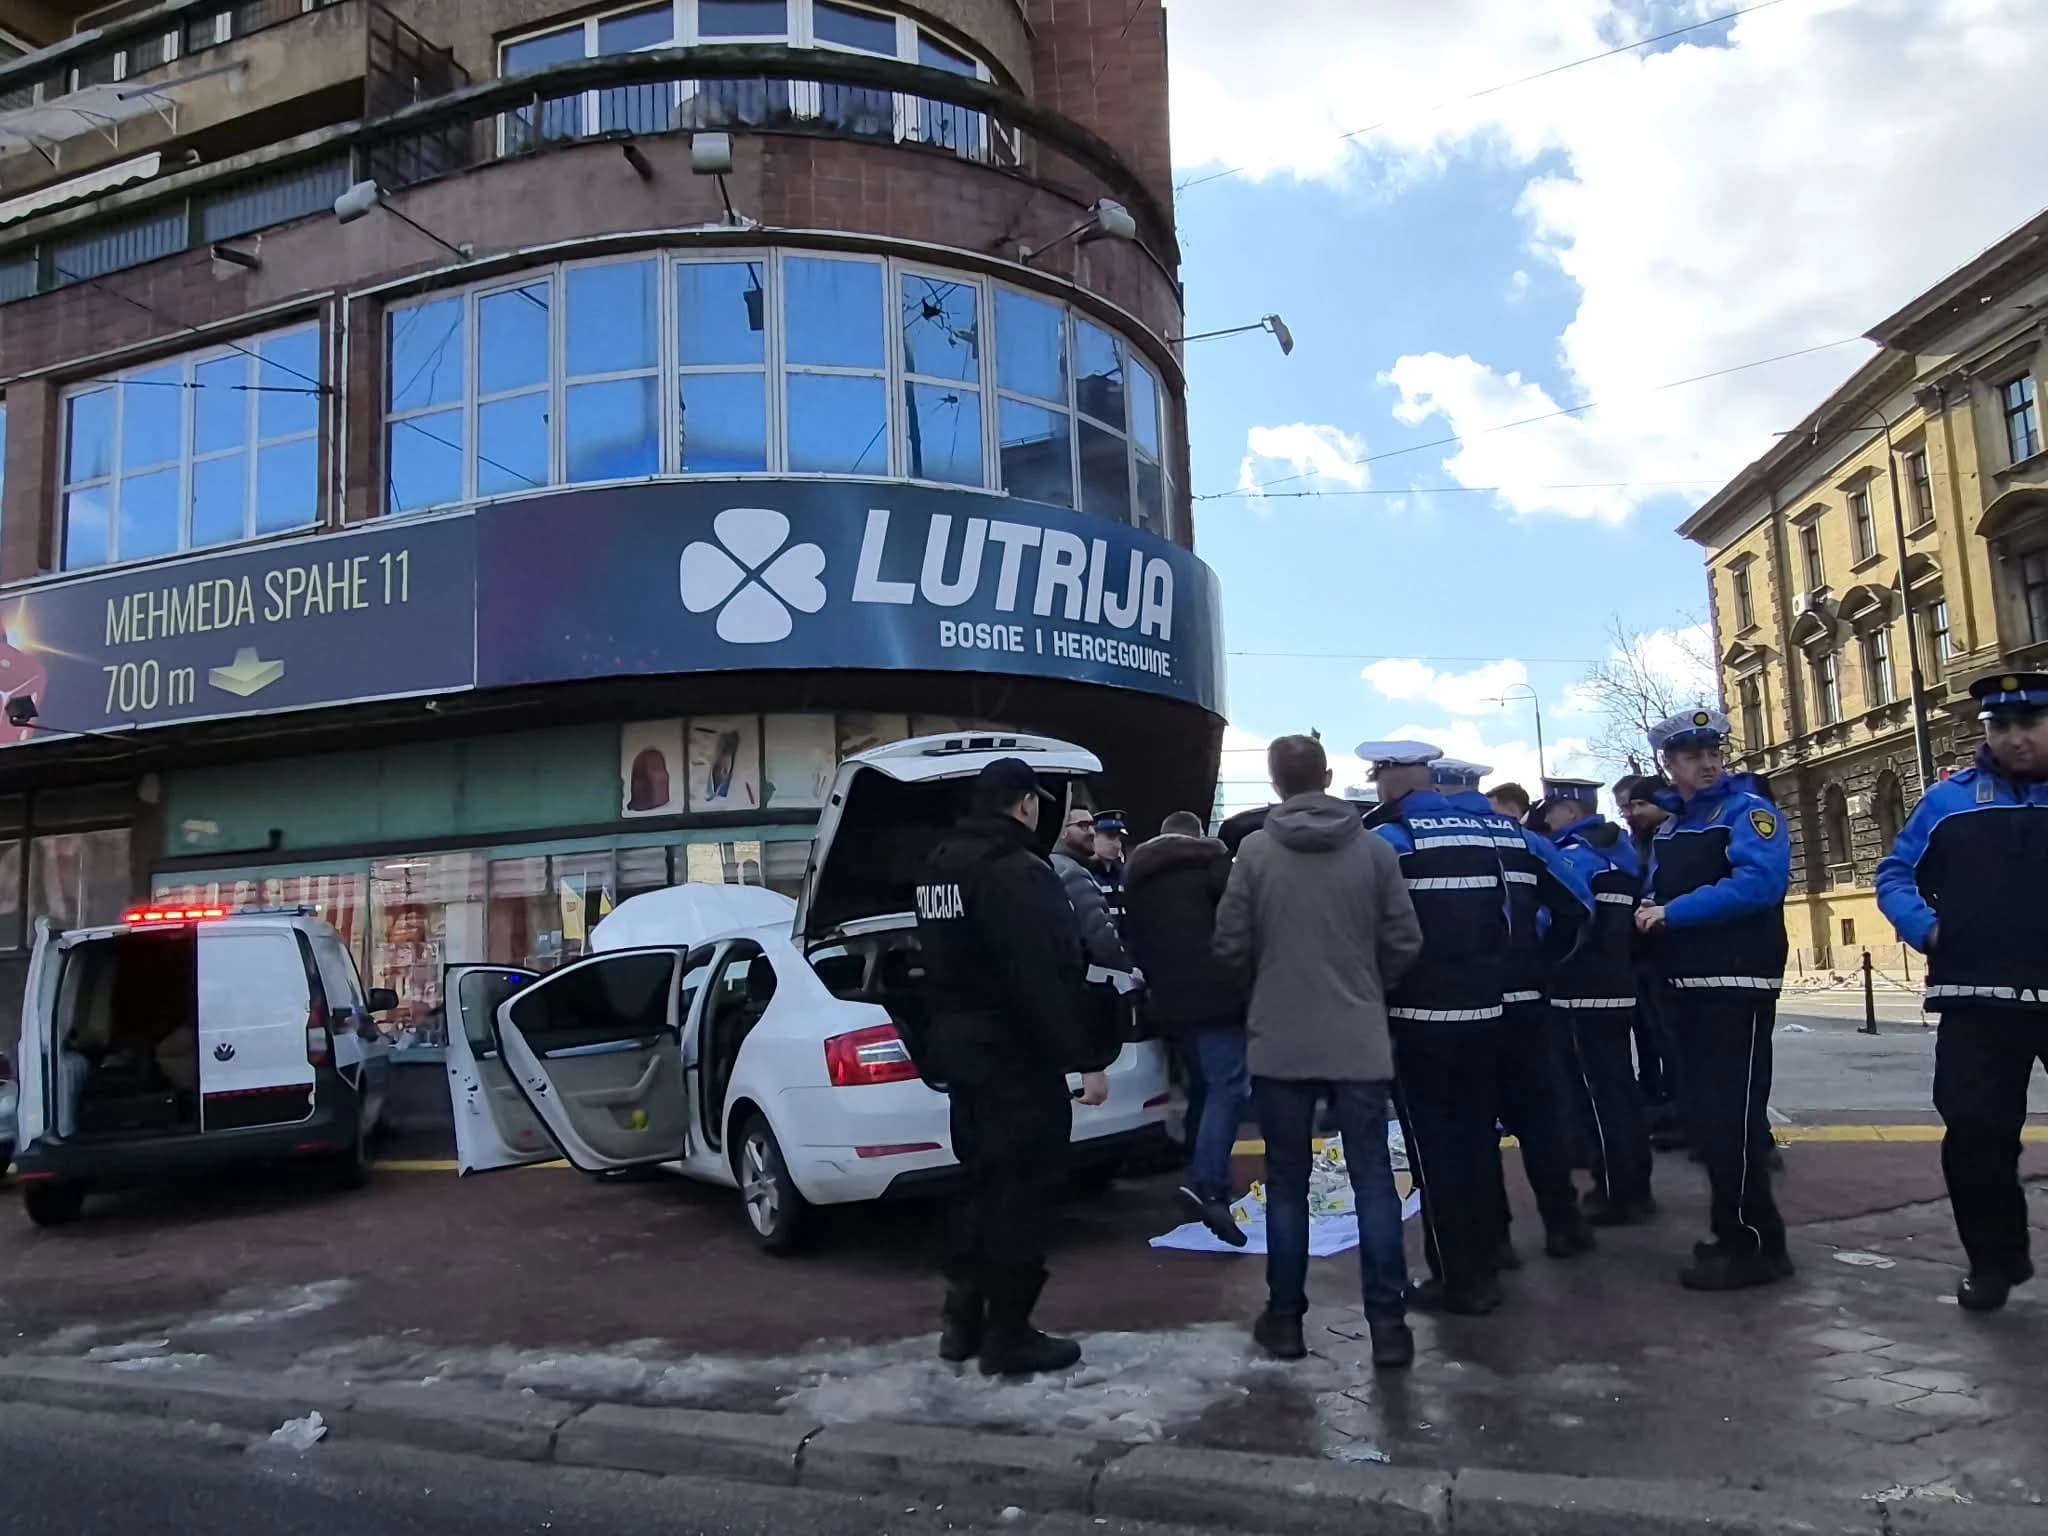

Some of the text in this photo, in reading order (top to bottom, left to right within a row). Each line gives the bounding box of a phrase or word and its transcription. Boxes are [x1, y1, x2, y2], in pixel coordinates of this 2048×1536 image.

[851, 508, 1173, 642] LUTRIJA
[105, 549, 409, 647] MEHMEDA SPAHE 11
[939, 620, 1024, 653] BOSNE
[1035, 628, 1043, 655] I
[103, 659, 195, 714] 700 m
[1408, 817, 1483, 830] POLICIJA
[916, 884, 965, 919] POLICIJA
